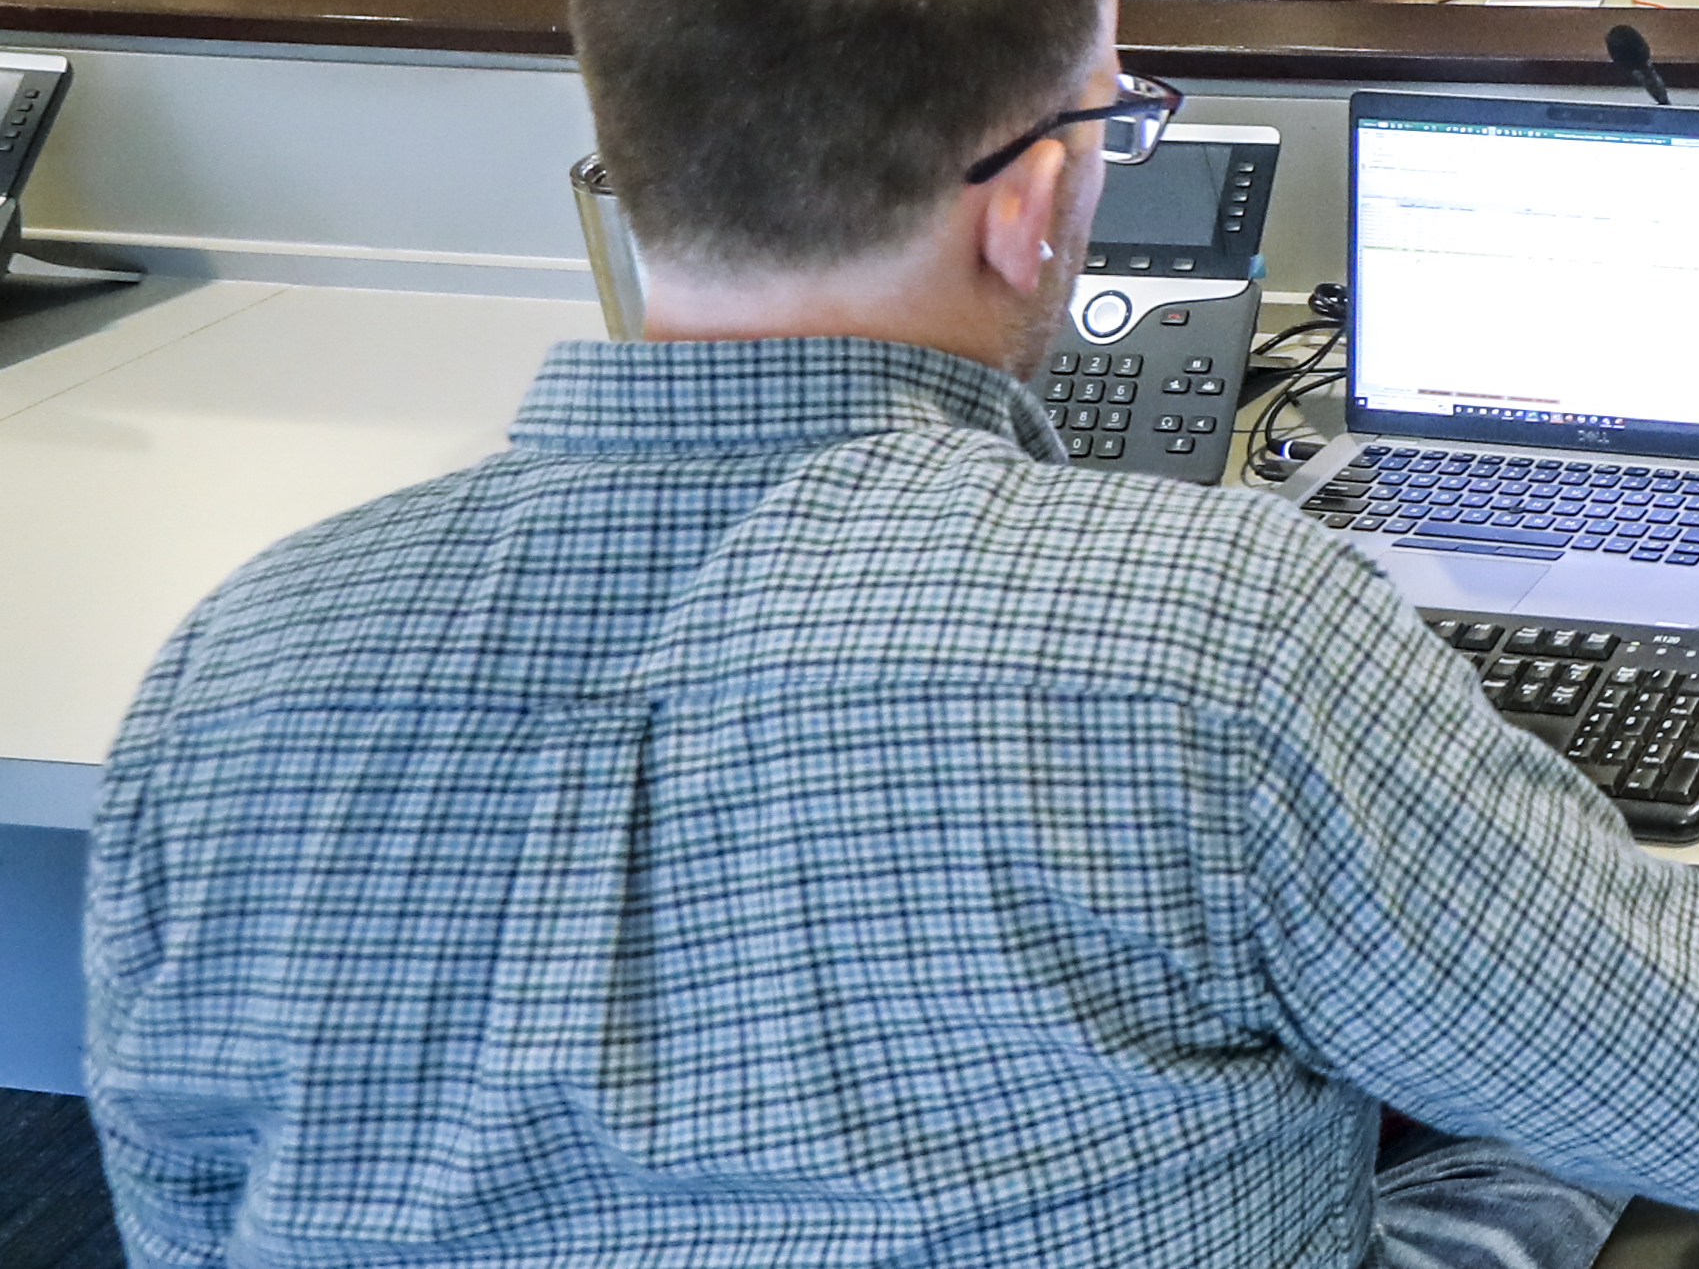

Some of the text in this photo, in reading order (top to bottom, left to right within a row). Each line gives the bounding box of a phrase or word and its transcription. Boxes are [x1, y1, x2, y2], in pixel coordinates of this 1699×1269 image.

[1062, 355, 1068, 365] 1
[1091, 357, 1100, 367] 2
[1123, 358, 1132, 368] 3
[1053, 383, 1062, 392] 4
[1085, 384, 1094, 394] 5
[1117, 385, 1125, 395] 6
[1049, 410, 1057, 419] 7
[1079, 411, 1088, 421] 8
[1111, 412, 1119, 422] 9
[1073, 438, 1082, 449] 0
[1653, 635, 1681, 644] K120
